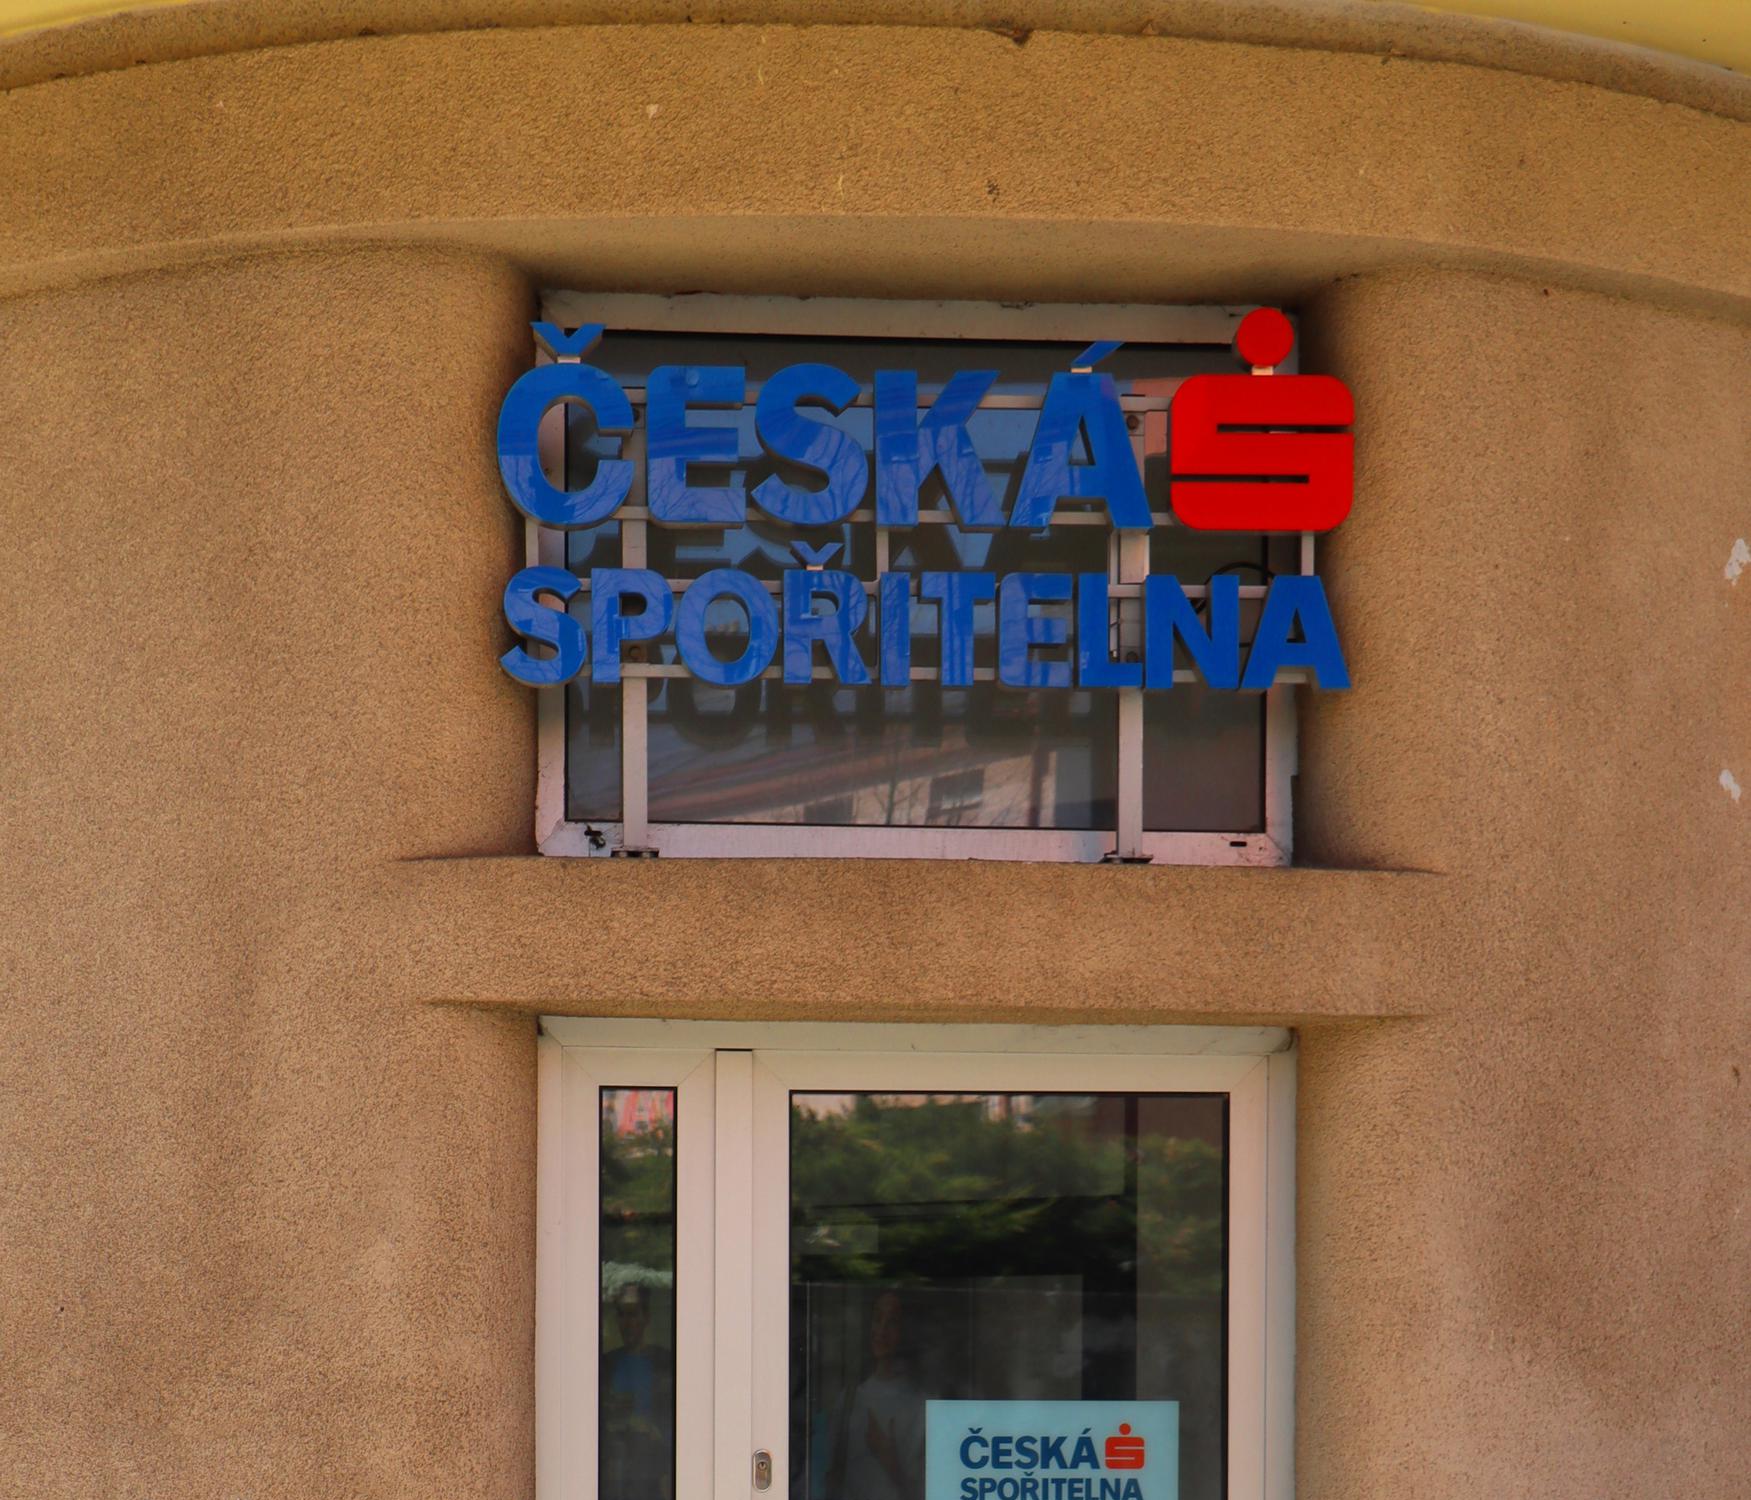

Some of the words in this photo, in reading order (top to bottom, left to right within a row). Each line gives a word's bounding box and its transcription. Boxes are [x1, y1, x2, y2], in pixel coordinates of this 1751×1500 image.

[496, 321, 1153, 530] ČESKÁ
[499, 541, 1352, 690] SPOŘITELNA
[959, 1427, 1100, 1470] ČESKÁ
